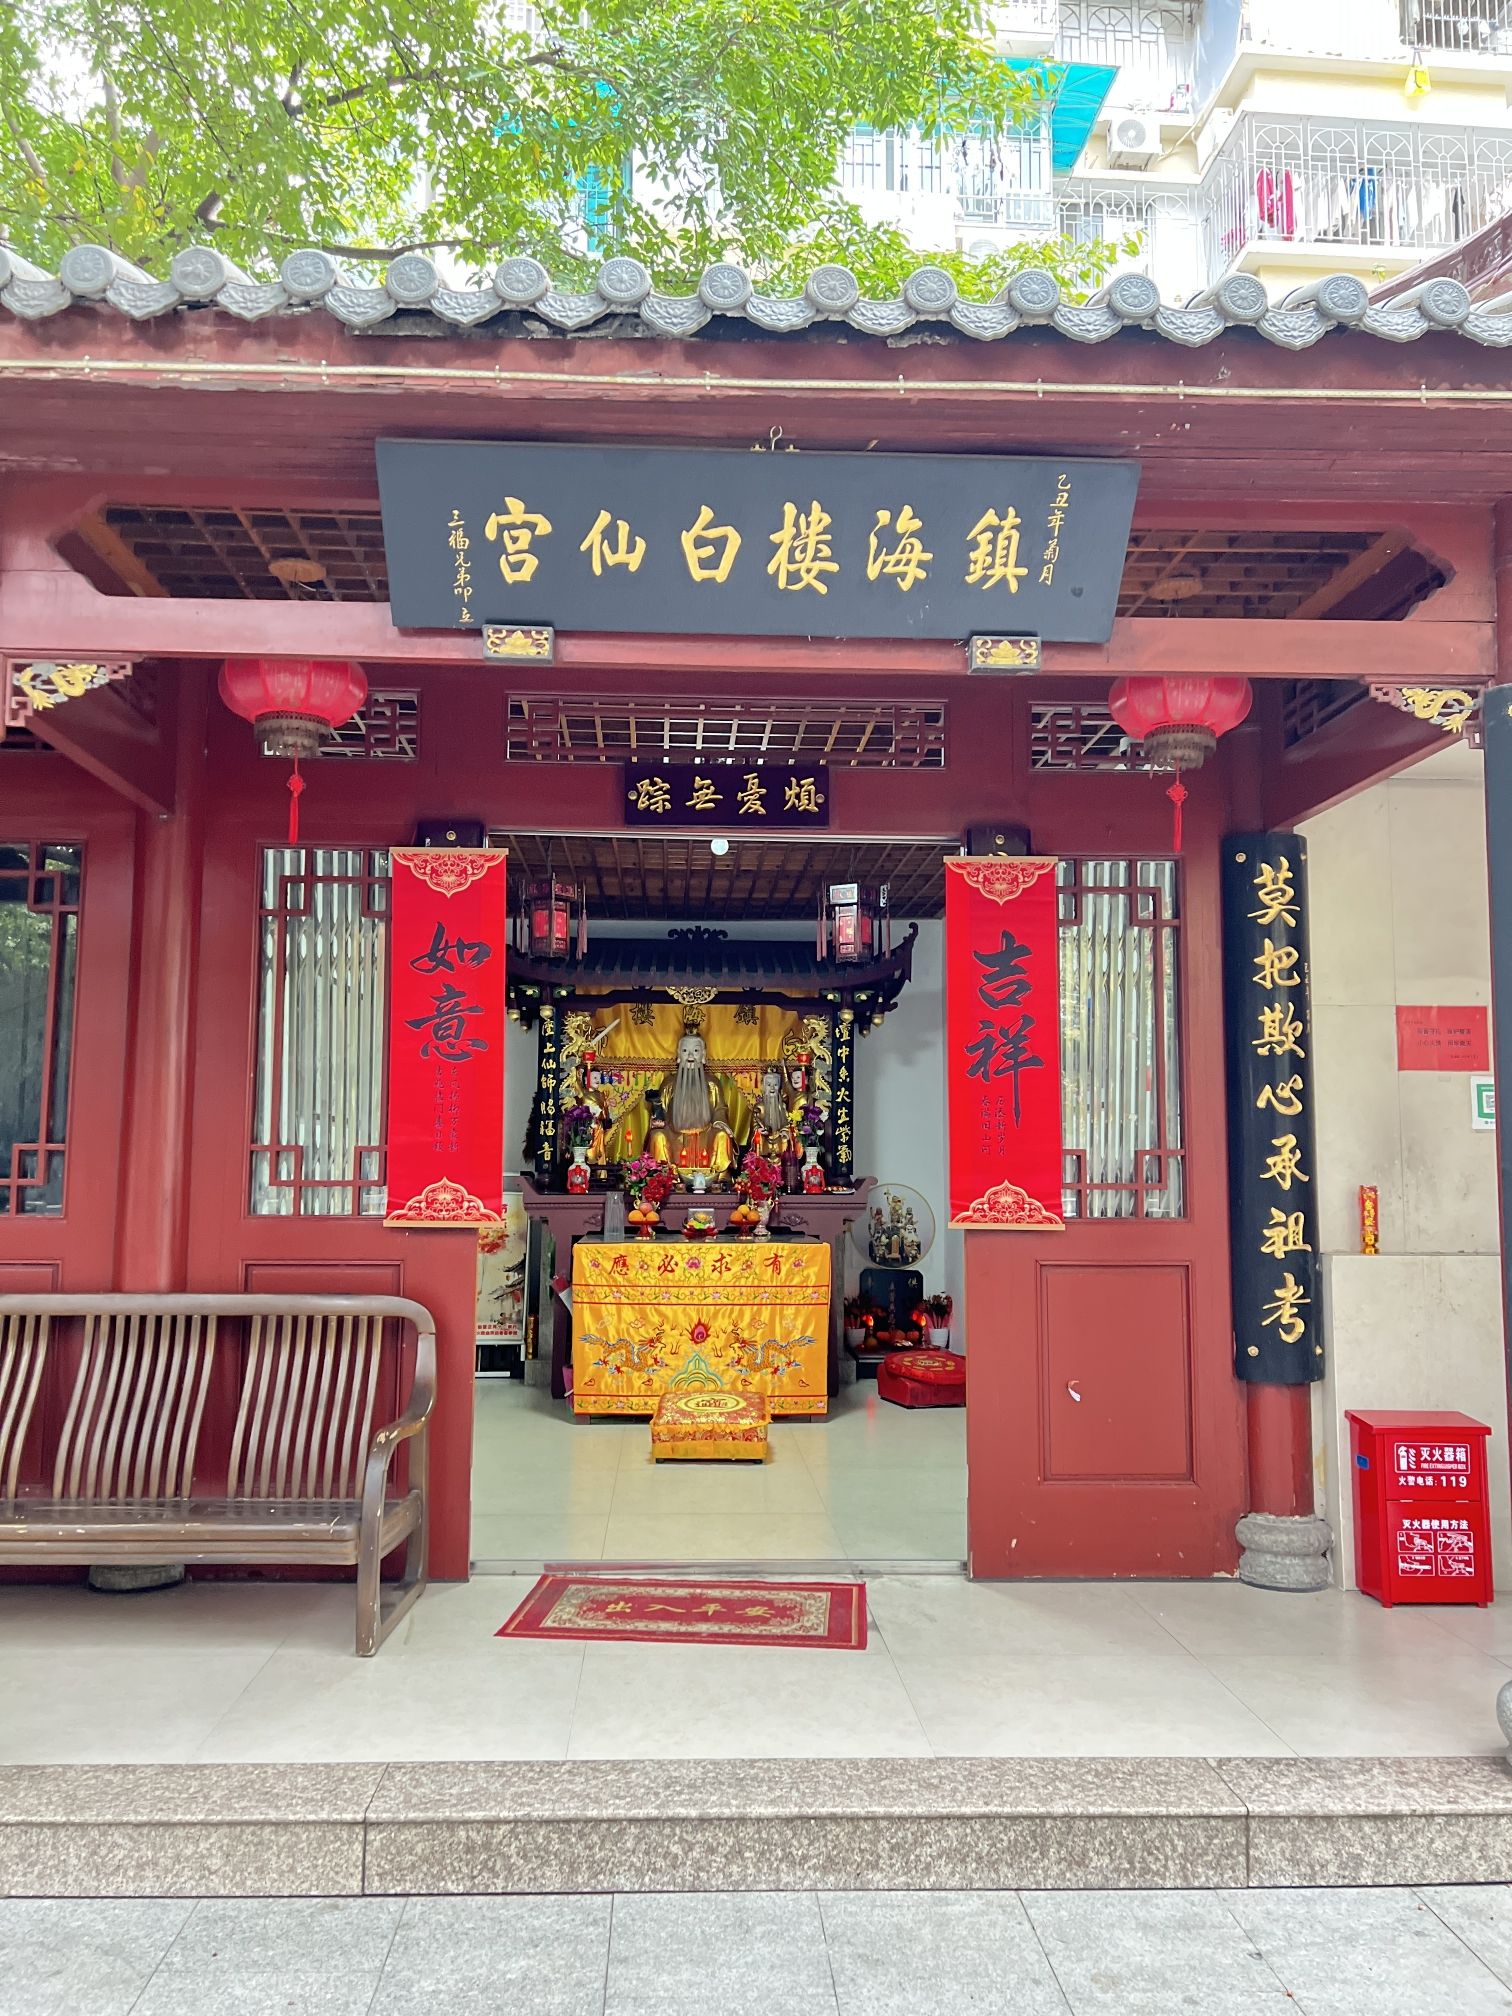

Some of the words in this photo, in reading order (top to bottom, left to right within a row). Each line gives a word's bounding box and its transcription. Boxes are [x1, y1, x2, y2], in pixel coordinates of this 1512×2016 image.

[404, 921, 492, 1062] 如意
[964, 930, 1045, 1129] 吉祥
[1247, 857, 1312, 1344] 莫把欺心承祖考
[608, 1252, 785, 1277] 有求必應
[1420, 1447, 1467, 1462] 灭火器箱
[1402, 1519, 1469, 1530] 灭火器使用方法
[605, 1600, 776, 1618] 出入平安
